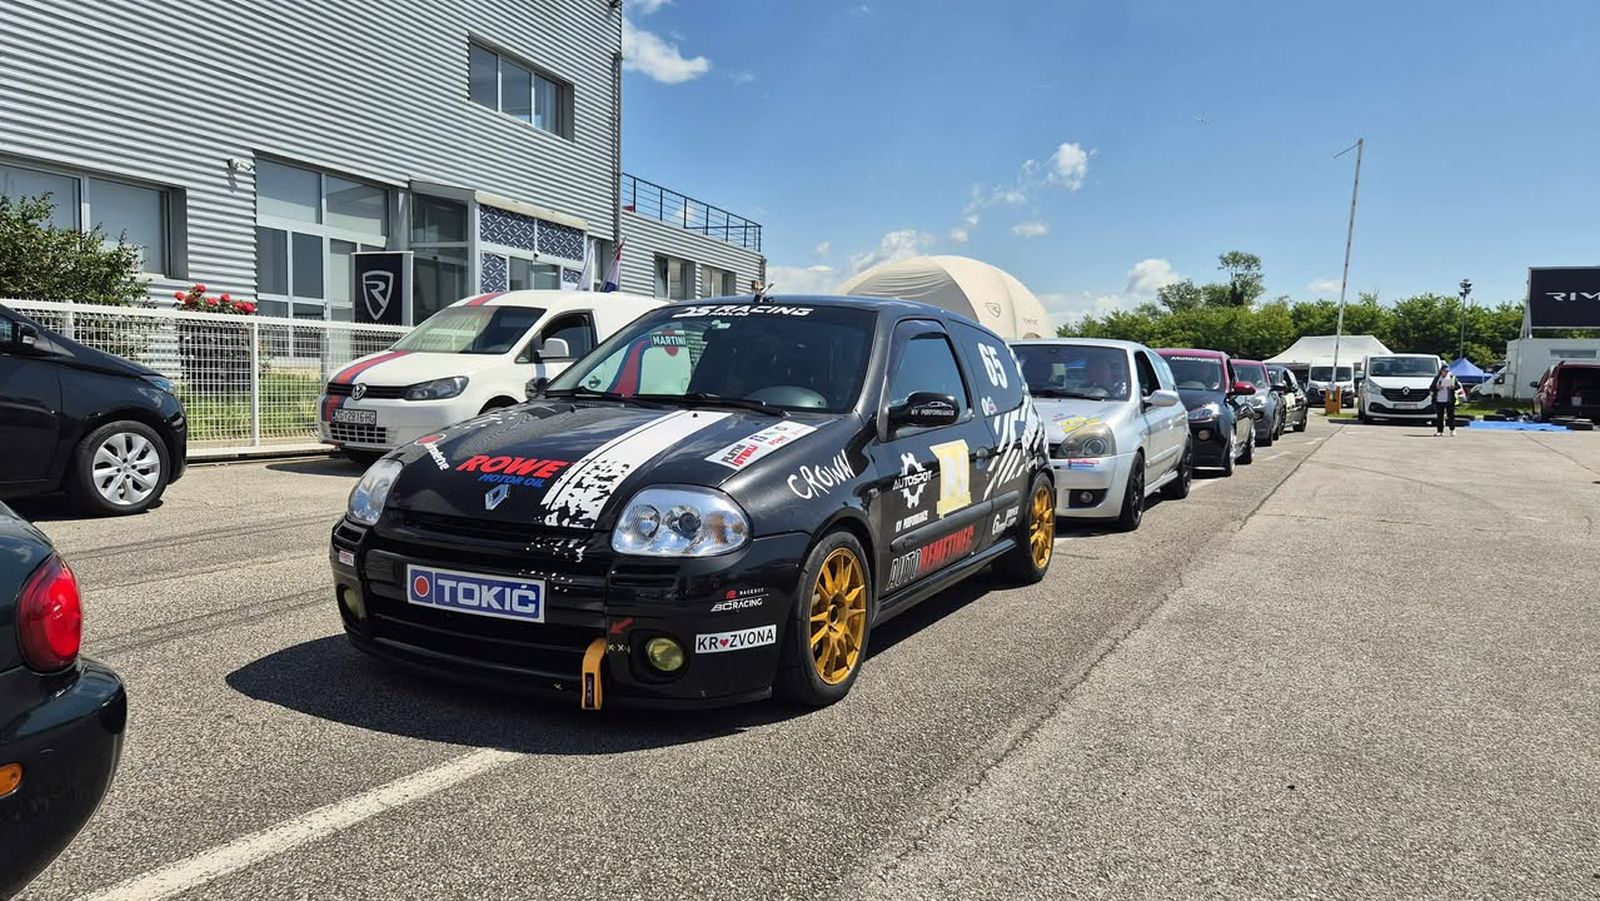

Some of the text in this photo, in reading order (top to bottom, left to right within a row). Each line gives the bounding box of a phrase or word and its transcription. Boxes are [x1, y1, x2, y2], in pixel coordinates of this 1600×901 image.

[715, 305, 814, 316] RACING
[652, 335, 687, 346] MARTINI
[977, 342, 1008, 389] 65
[456, 454, 568, 479] ROWE
[478, 474, 546, 488] MOTOR OIL
[892, 470, 933, 491] AUTOSPOT
[437, 579, 536, 614] TOKIĆ
